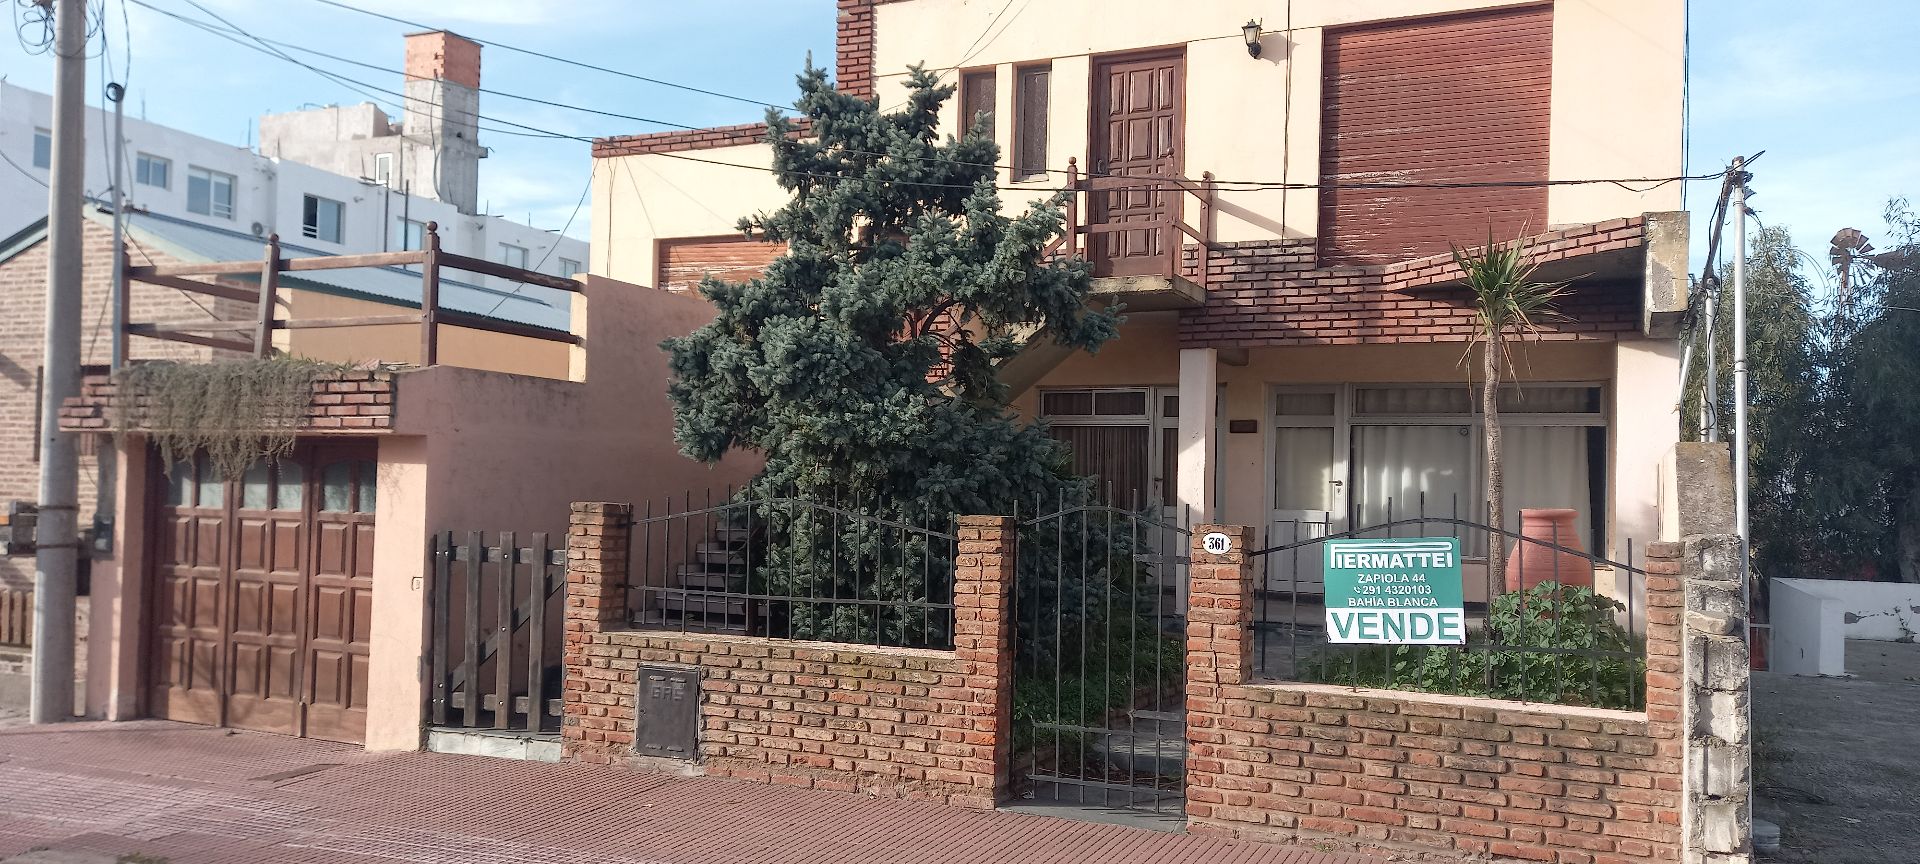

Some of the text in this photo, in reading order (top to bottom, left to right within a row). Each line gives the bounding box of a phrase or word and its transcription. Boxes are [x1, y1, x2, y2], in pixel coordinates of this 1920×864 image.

[1208, 537, 1224, 550] 361
[1330, 541, 1453, 569] PIERMATTEI
[1357, 573, 1426, 583] ZAPIOLA 44
[1362, 585, 1432, 595] 291 4320103
[1348, 596, 1439, 607] BAHÍA BLANCA
[1330, 612, 1461, 640] VENDE
[652, 686, 684, 700] GAS
